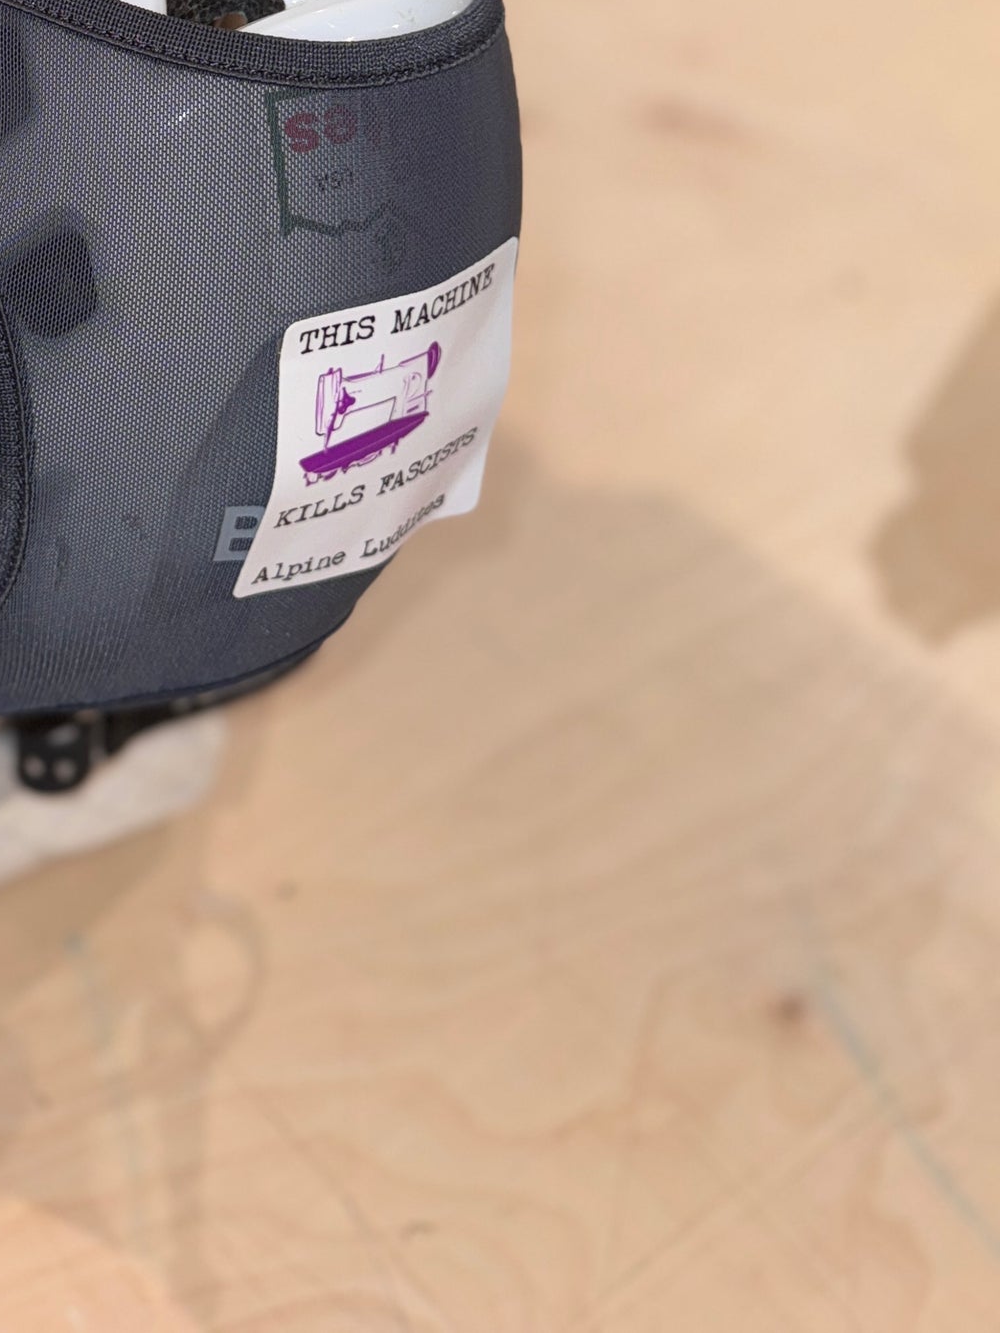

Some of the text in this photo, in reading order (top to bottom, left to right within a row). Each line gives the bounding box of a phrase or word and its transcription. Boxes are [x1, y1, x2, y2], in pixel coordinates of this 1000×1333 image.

[299, 262, 496, 355] THIS MACHINE
[273, 426, 479, 528] KILLS FASCISTS
[250, 493, 446, 585] Alpine Luddites
